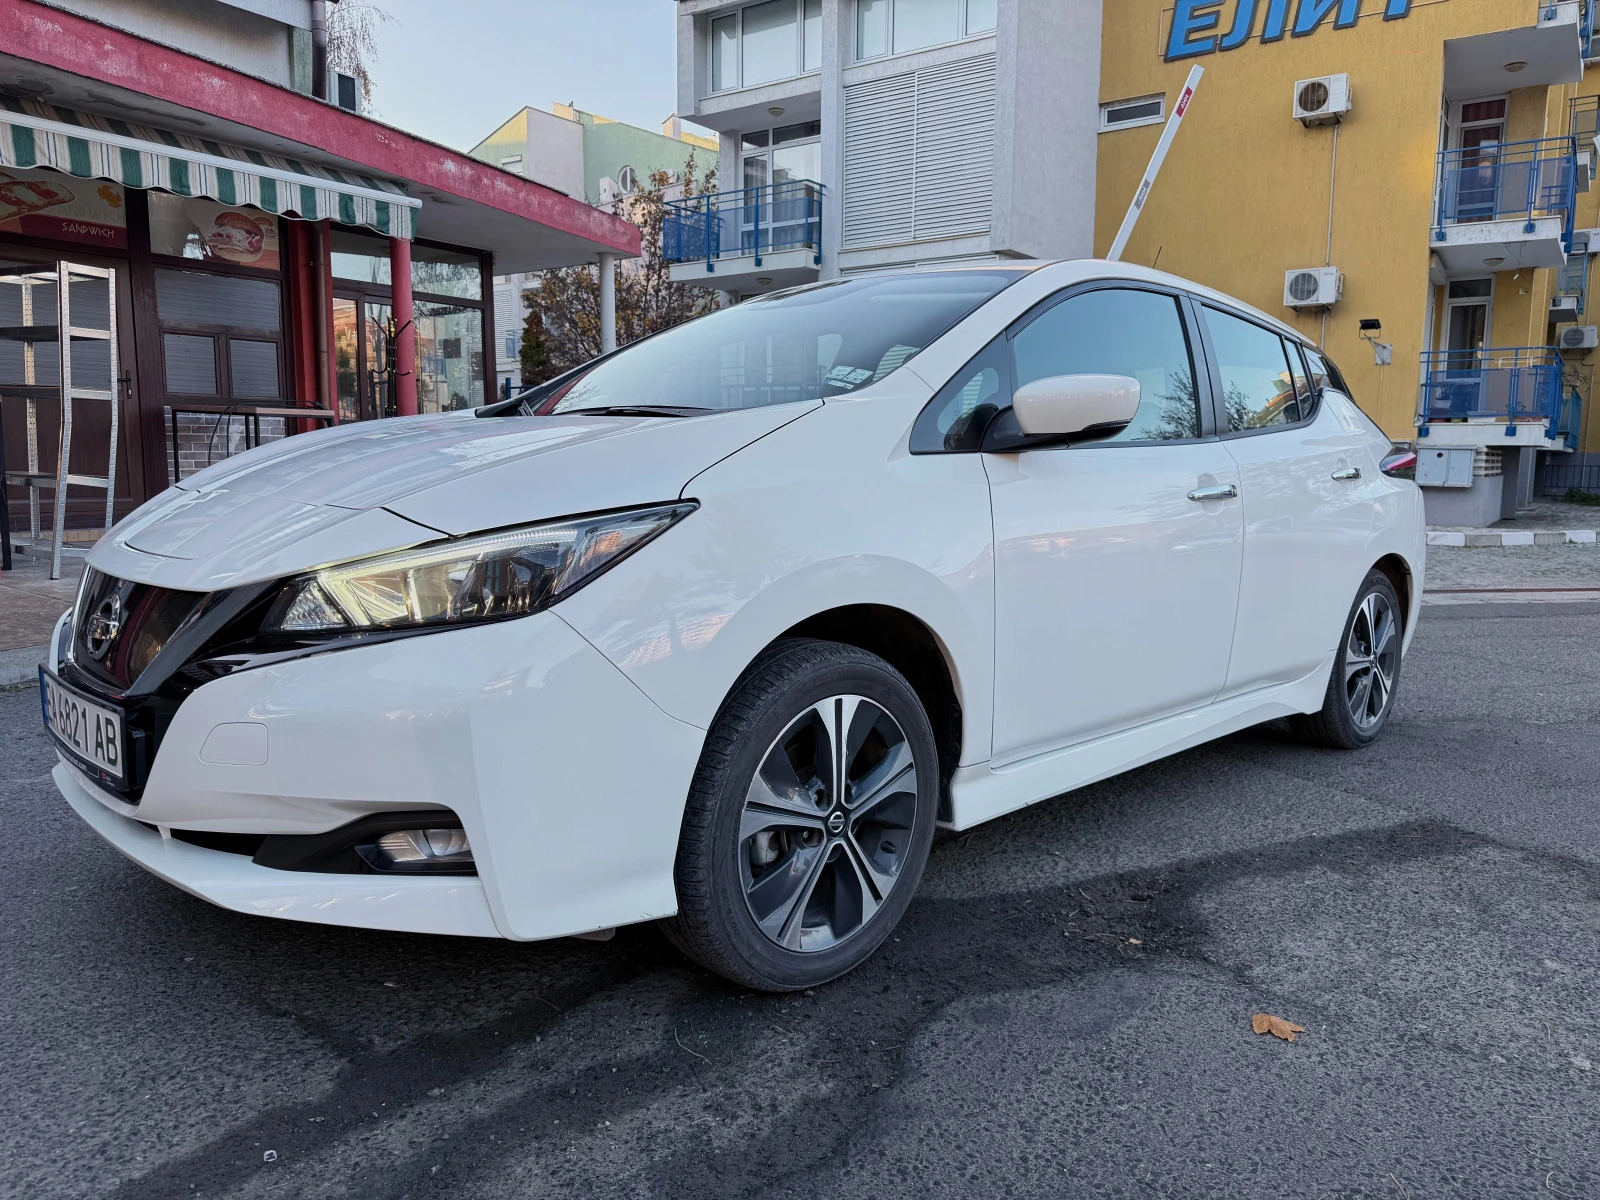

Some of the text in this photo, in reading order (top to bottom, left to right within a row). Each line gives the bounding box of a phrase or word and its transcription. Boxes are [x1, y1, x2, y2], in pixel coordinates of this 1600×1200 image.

[62, 221, 115, 239] SANDWICH
[46, 681, 59, 728] EA
[59, 692, 90, 753] 6821
[95, 713, 119, 767] AB
